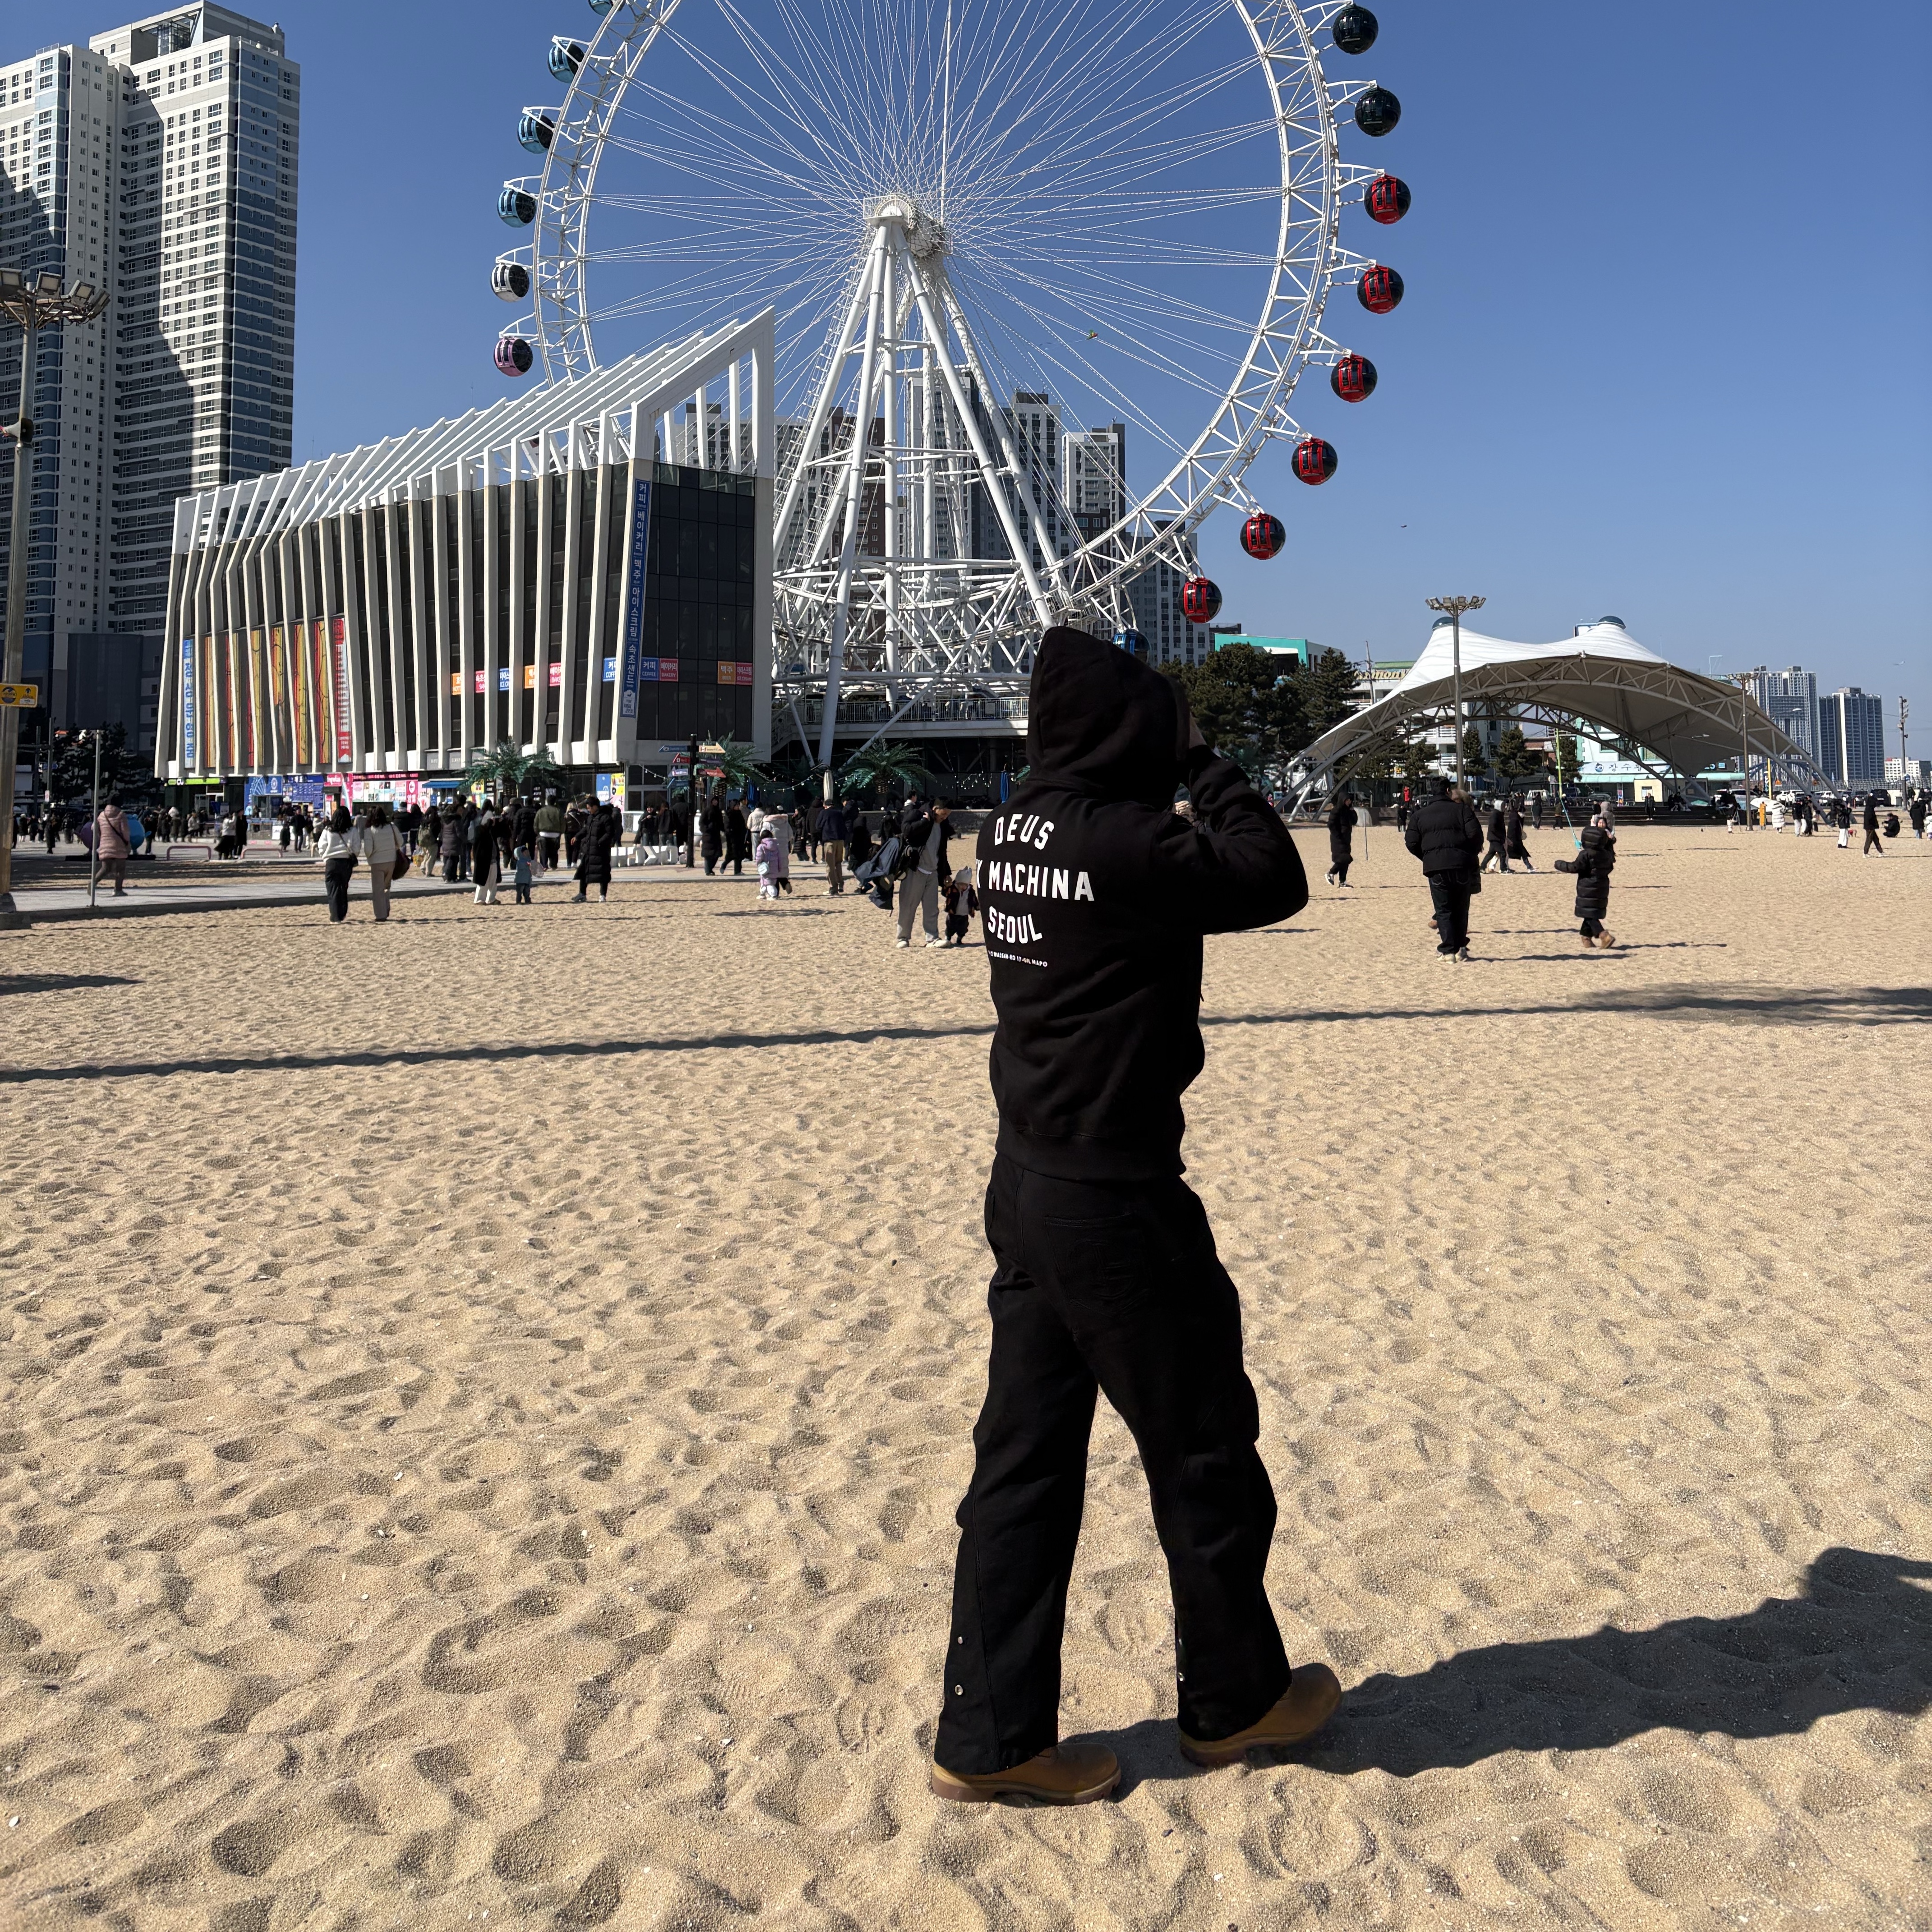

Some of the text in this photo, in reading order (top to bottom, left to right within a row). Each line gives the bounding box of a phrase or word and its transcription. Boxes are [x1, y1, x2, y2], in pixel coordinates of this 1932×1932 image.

[638, 483, 646, 504] 커피
[635, 511, 645, 552] 베이커리
[633, 559, 641, 580] 맥주
[630, 587, 640, 637] 아이스크림
[643, 661, 656, 670] 커피
[661, 662, 677, 672] 베이커리
[721, 665, 733, 674] 맥주
[994, 813, 1055, 850] DEUS
[988, 860, 1095, 902] MACHINA
[987, 906, 1043, 944] SEOUL
[1031, 959, 1048, 967] MAPO
